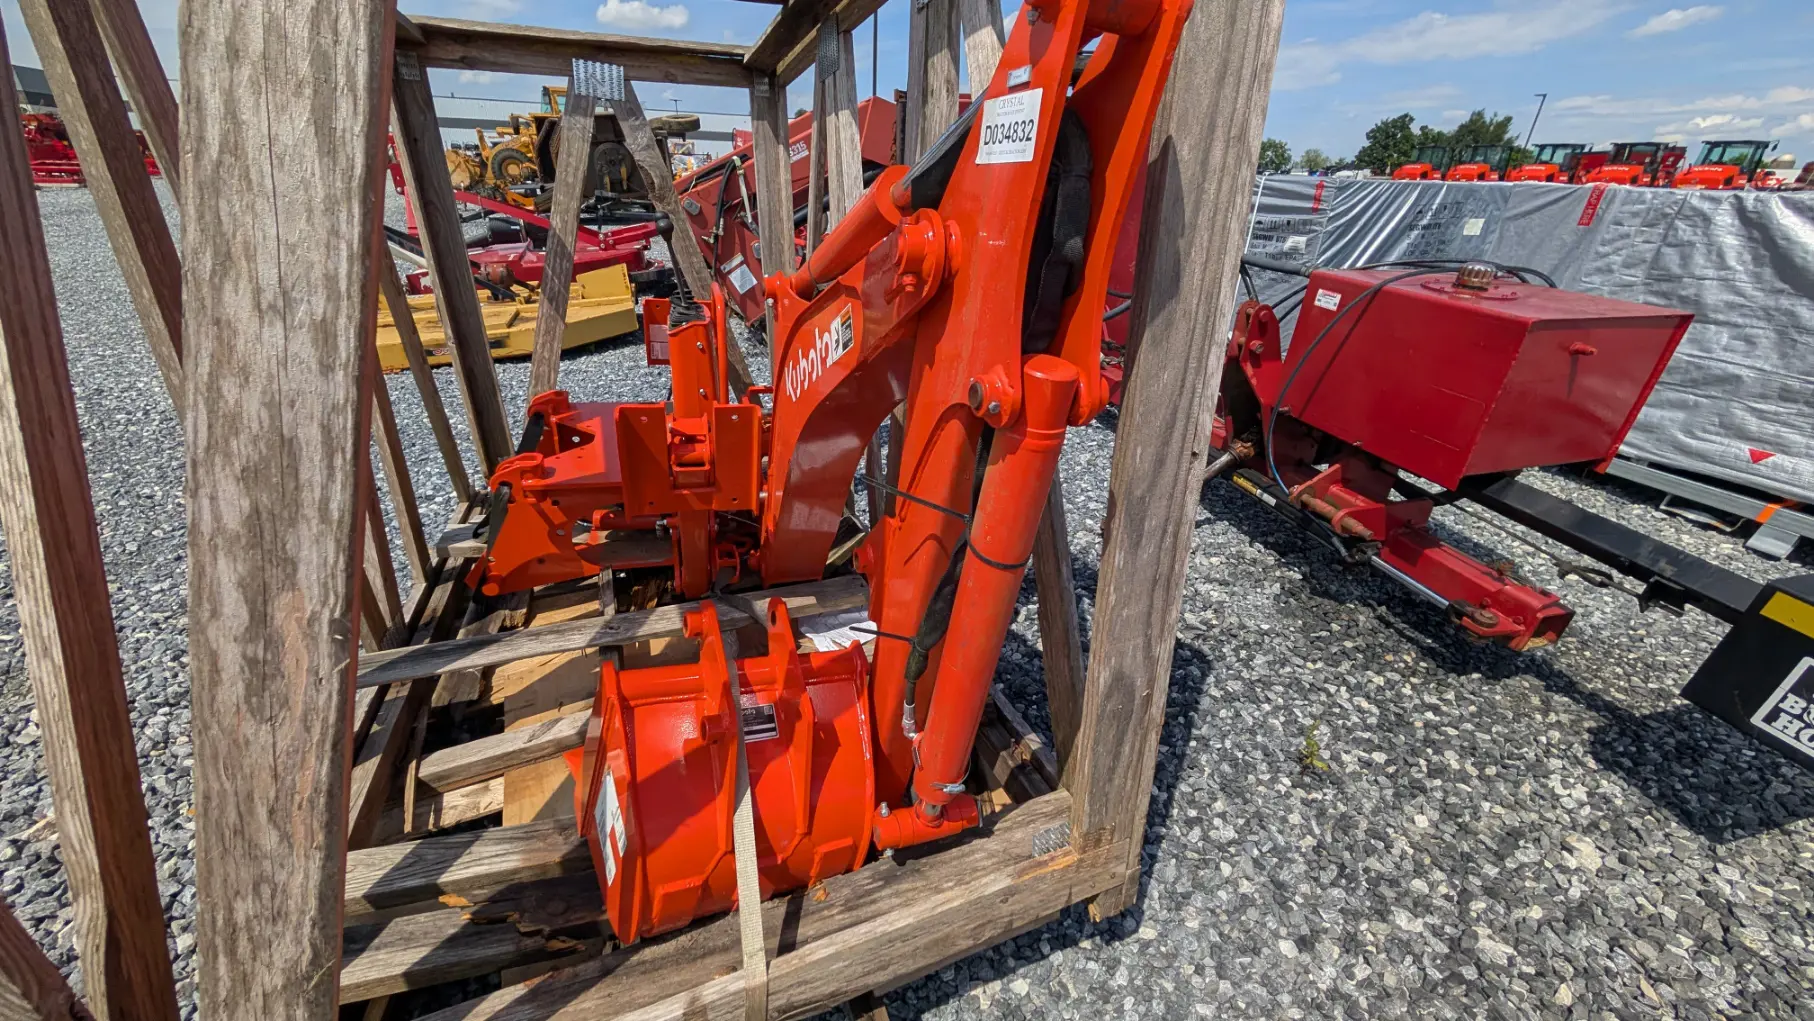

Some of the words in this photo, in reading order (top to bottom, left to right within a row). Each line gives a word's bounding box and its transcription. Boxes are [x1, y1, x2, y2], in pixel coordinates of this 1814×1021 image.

[998, 95, 1025, 110] CRYSTAL
[983, 118, 1035, 146] D034832
[784, 326, 833, 402] Kubota
